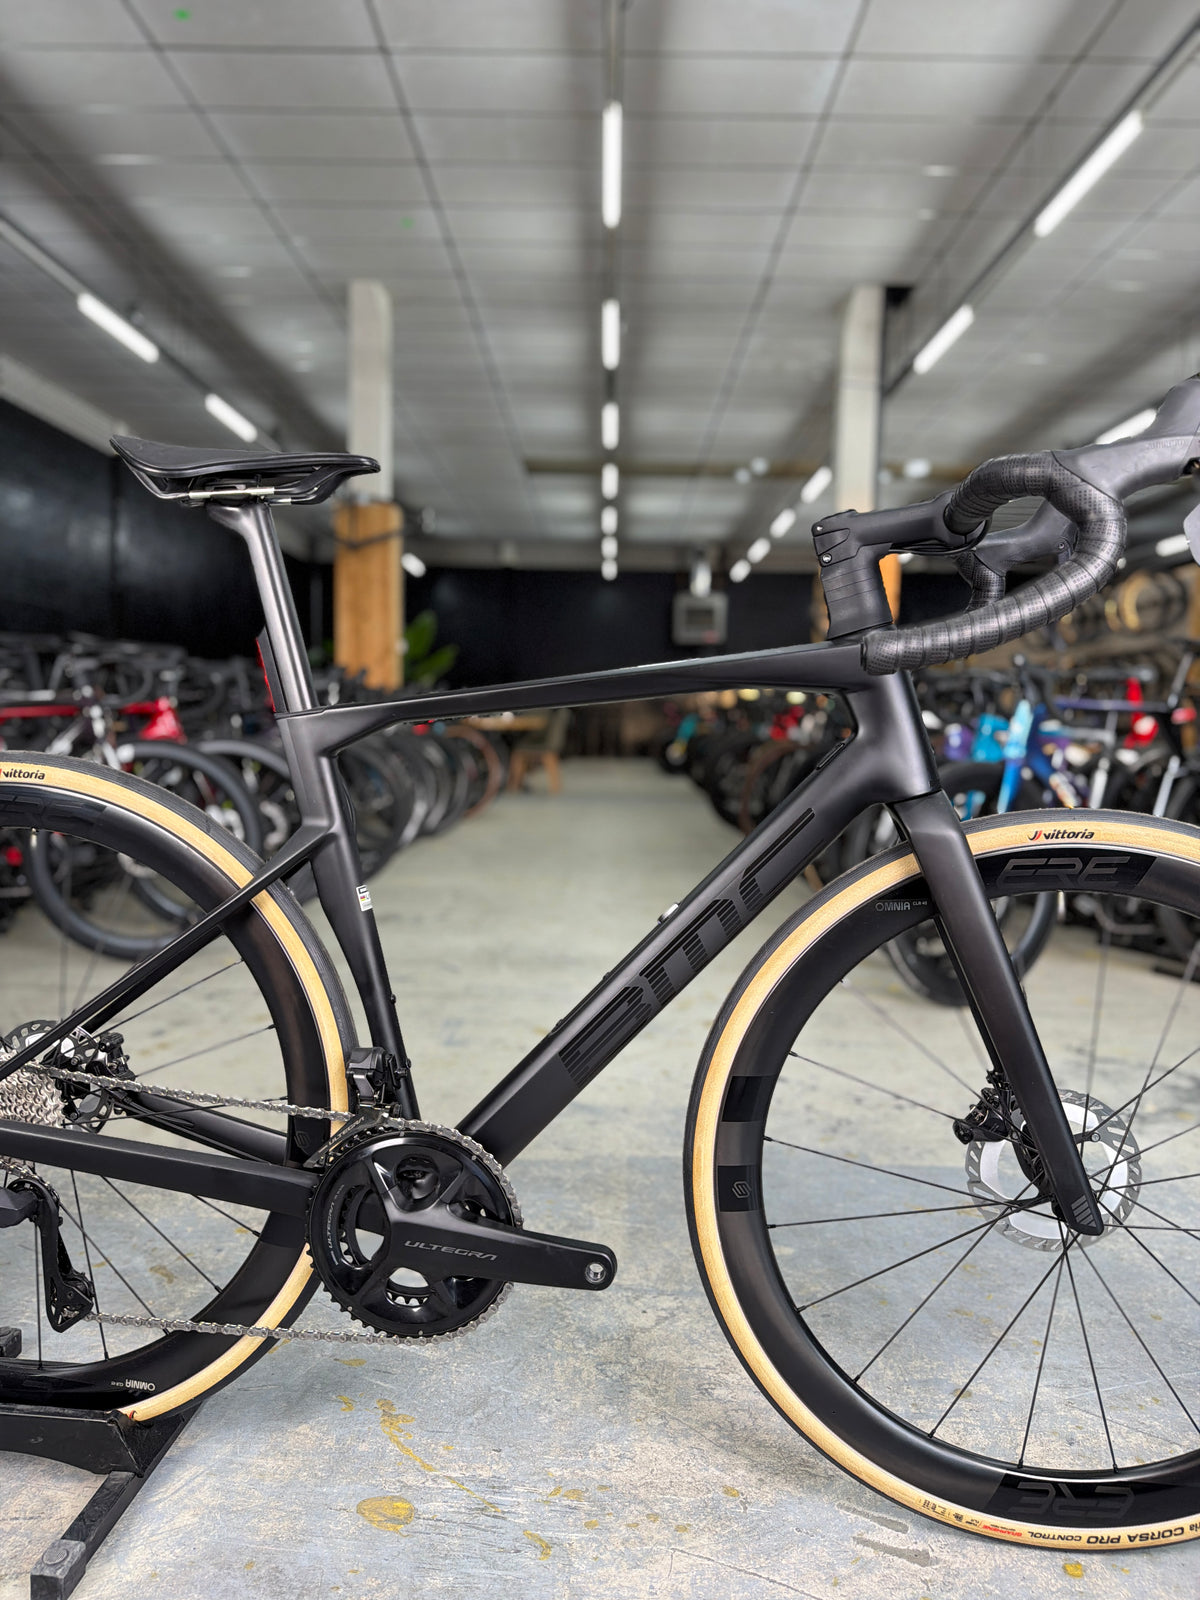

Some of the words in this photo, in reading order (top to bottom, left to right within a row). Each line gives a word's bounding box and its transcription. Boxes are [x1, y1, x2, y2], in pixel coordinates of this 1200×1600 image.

[3, 768, 46, 780] vittoria
[1043, 828, 1095, 840] vittoria
[996, 855, 1131, 889] ERE
[875, 901, 911, 912] OMNIA
[328, 1116, 365, 1146] ULTEGRA
[326, 1201, 335, 1249] ULTEGRA
[404, 1240, 498, 1261] ULTEGRA
[125, 1379, 156, 1391] OMNIA
[1027, 1530, 1083, 1542] CONTROL
[1086, 1535, 1122, 1545] PRO
[1127, 1526, 1185, 1543] CORSA
